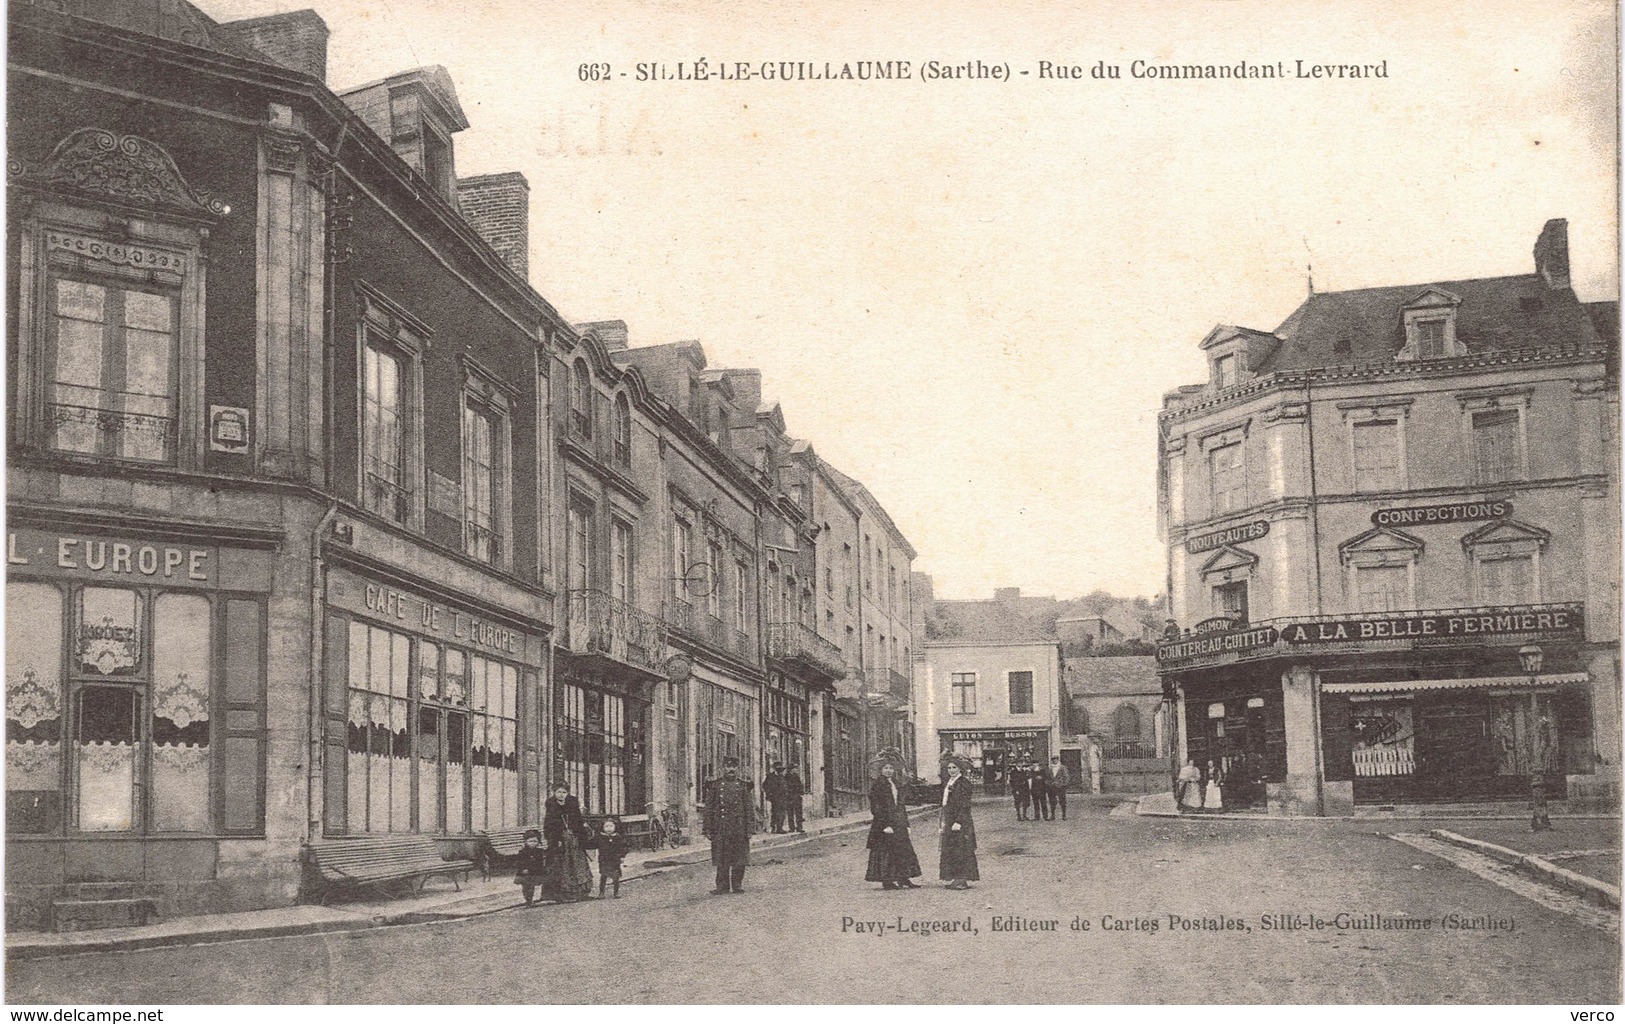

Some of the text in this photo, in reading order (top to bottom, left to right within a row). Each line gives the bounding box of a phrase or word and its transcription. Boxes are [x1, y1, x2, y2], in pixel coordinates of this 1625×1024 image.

[1377, 502, 1505, 525] CONFECTIONS
[1188, 521, 1264, 551] NOUVEAUTÉS
[422, 603, 440, 631] DE
[1293, 626, 1308, 641] A
[1318, 625, 1349, 641] LA
[1360, 620, 1437, 640] BELLE
